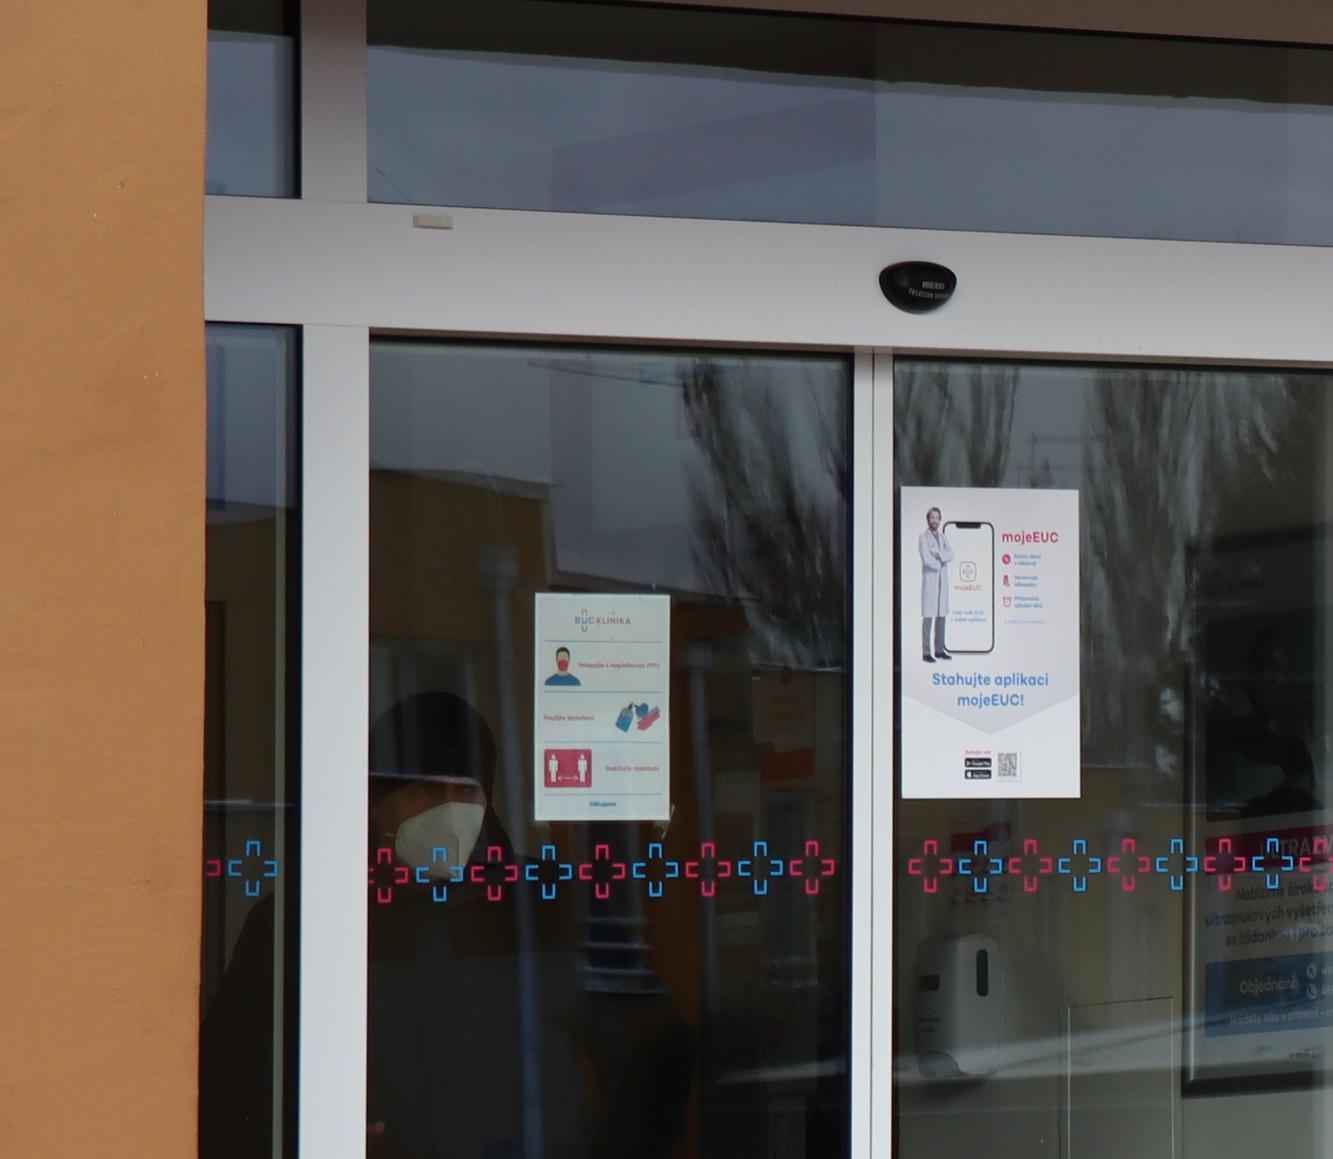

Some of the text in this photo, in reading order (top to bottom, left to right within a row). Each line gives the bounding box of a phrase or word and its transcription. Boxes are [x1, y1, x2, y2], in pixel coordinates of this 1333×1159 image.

[1002, 531, 1059, 545] mojeEUC
[596, 616, 631, 625] KLINIKA
[932, 672, 1049, 689] Stahujte aplikaci
[957, 694, 1024, 709] mojeEUC!
